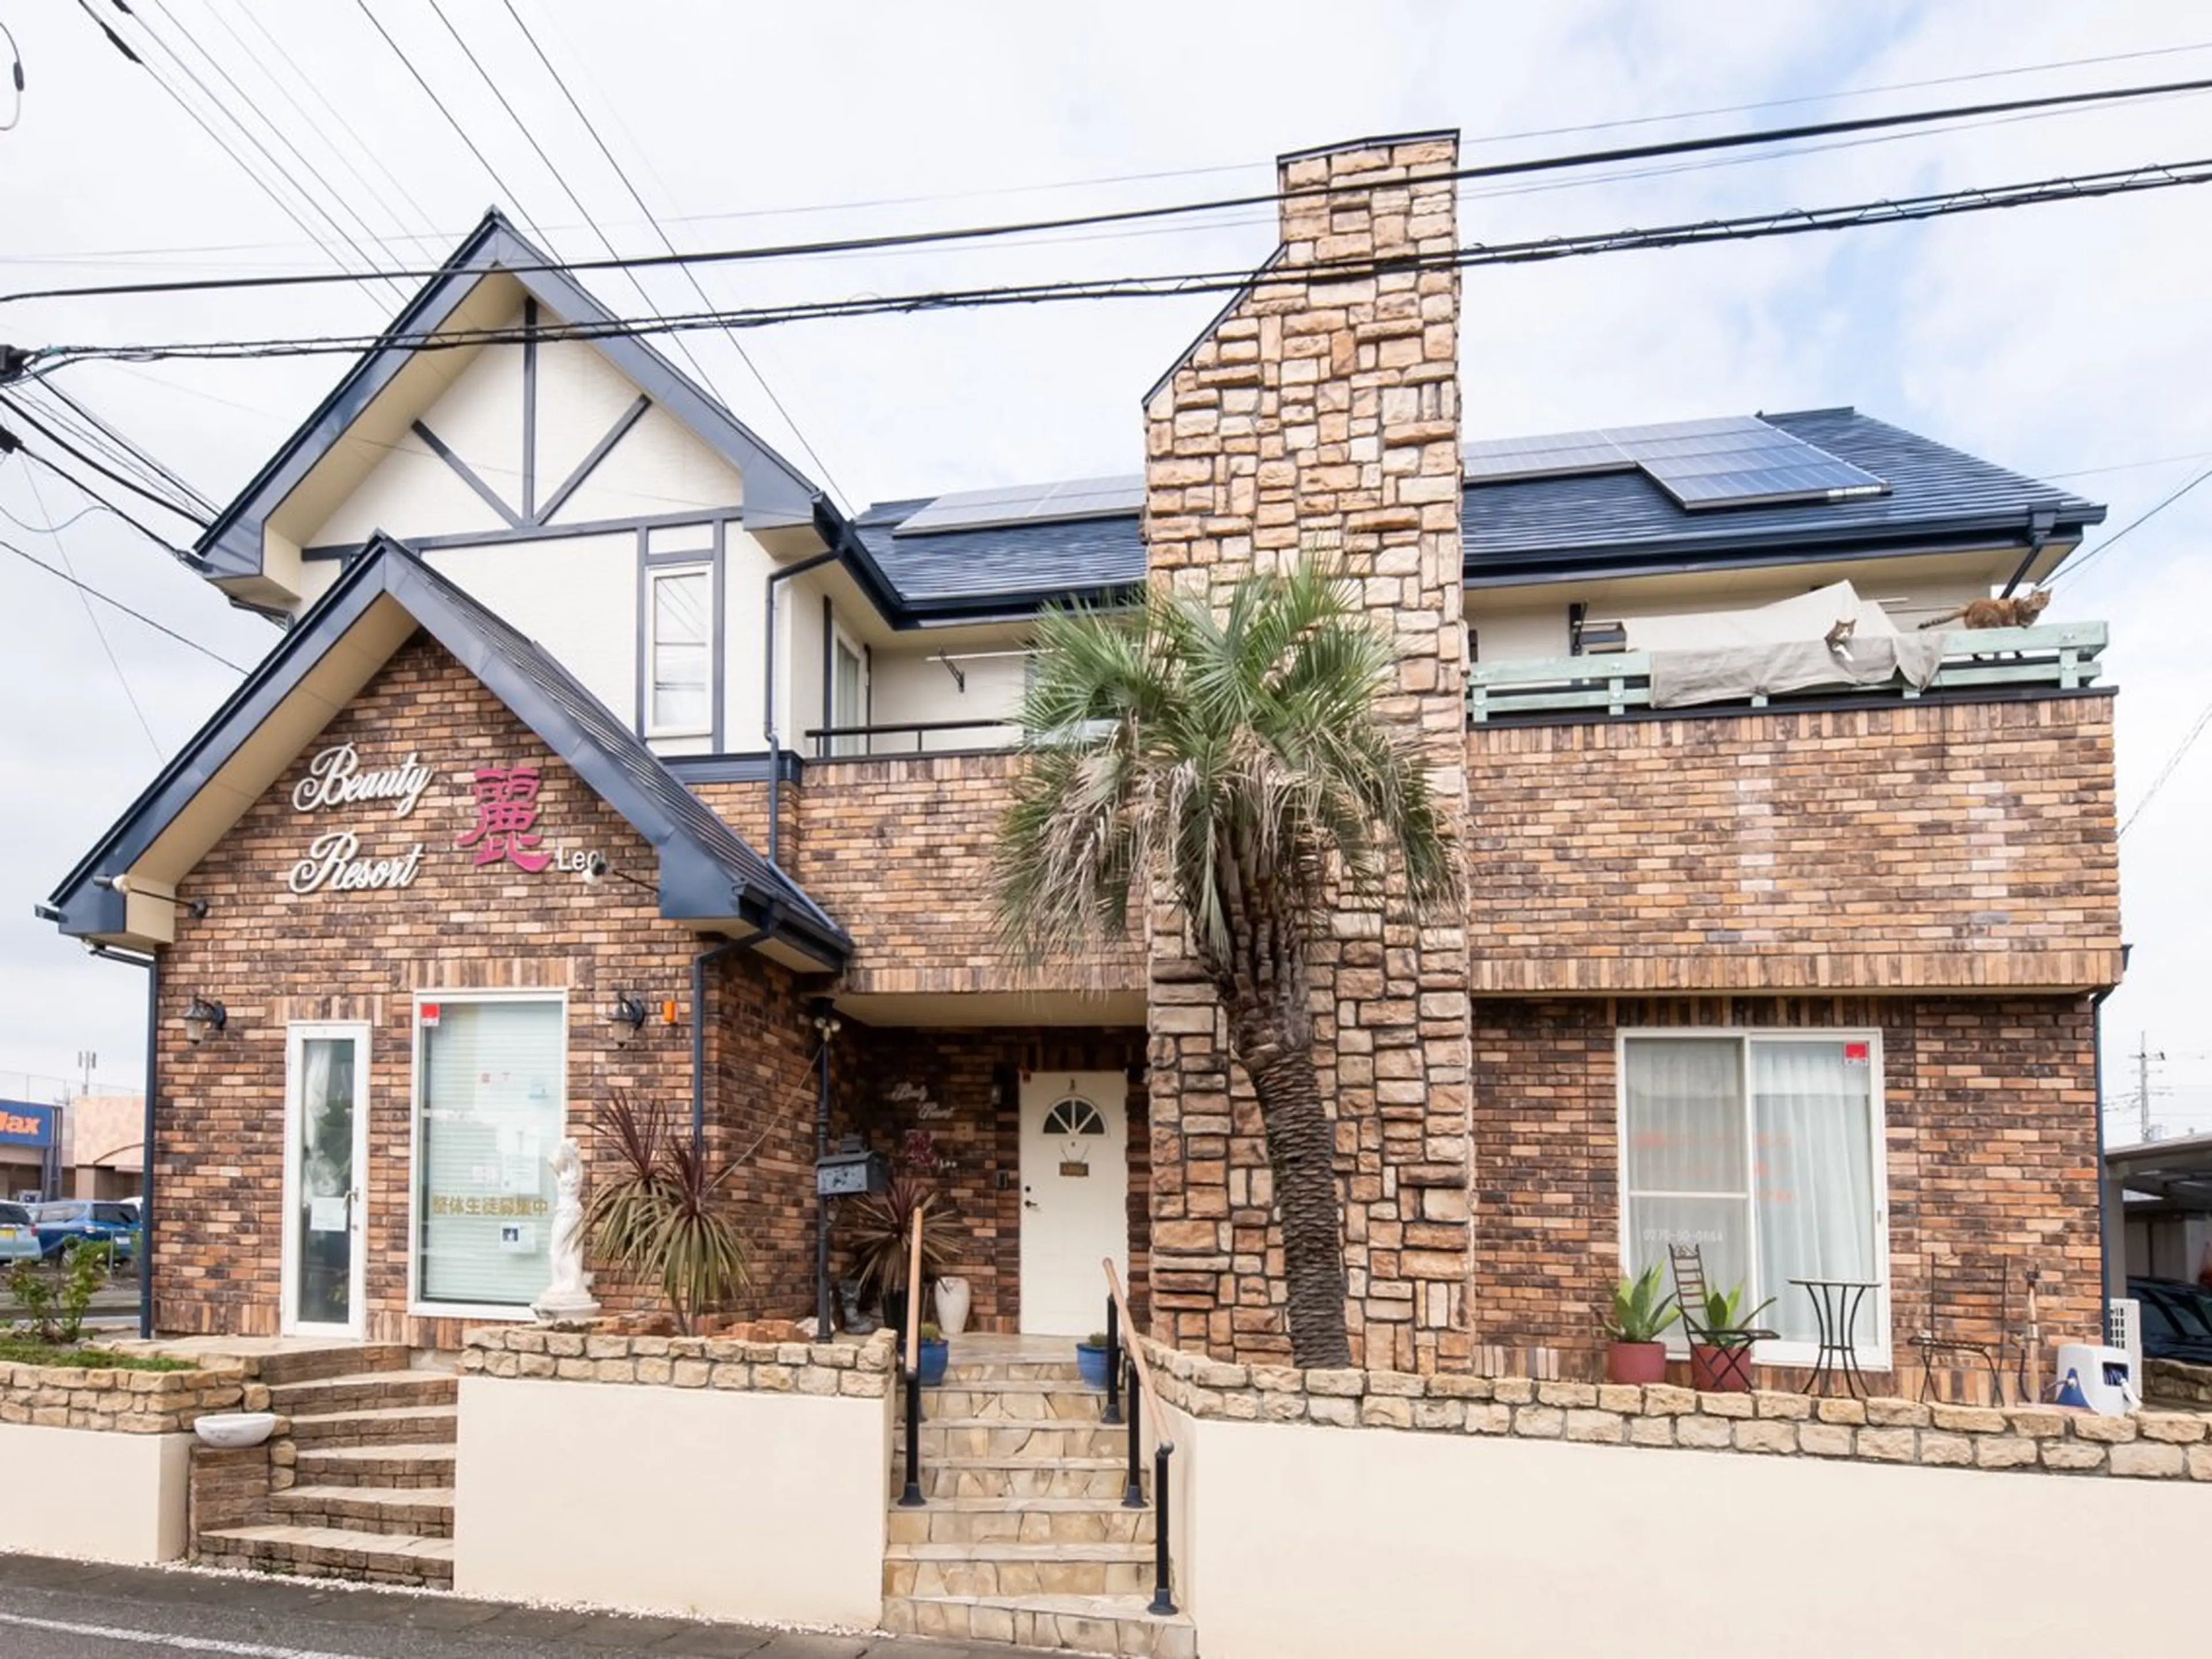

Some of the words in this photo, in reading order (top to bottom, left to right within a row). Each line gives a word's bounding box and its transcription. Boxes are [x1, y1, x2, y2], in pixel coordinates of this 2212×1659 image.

[292, 742, 434, 817] Beauty
[456, 767, 554, 873] 麗
[290, 830, 425, 893] Resort
